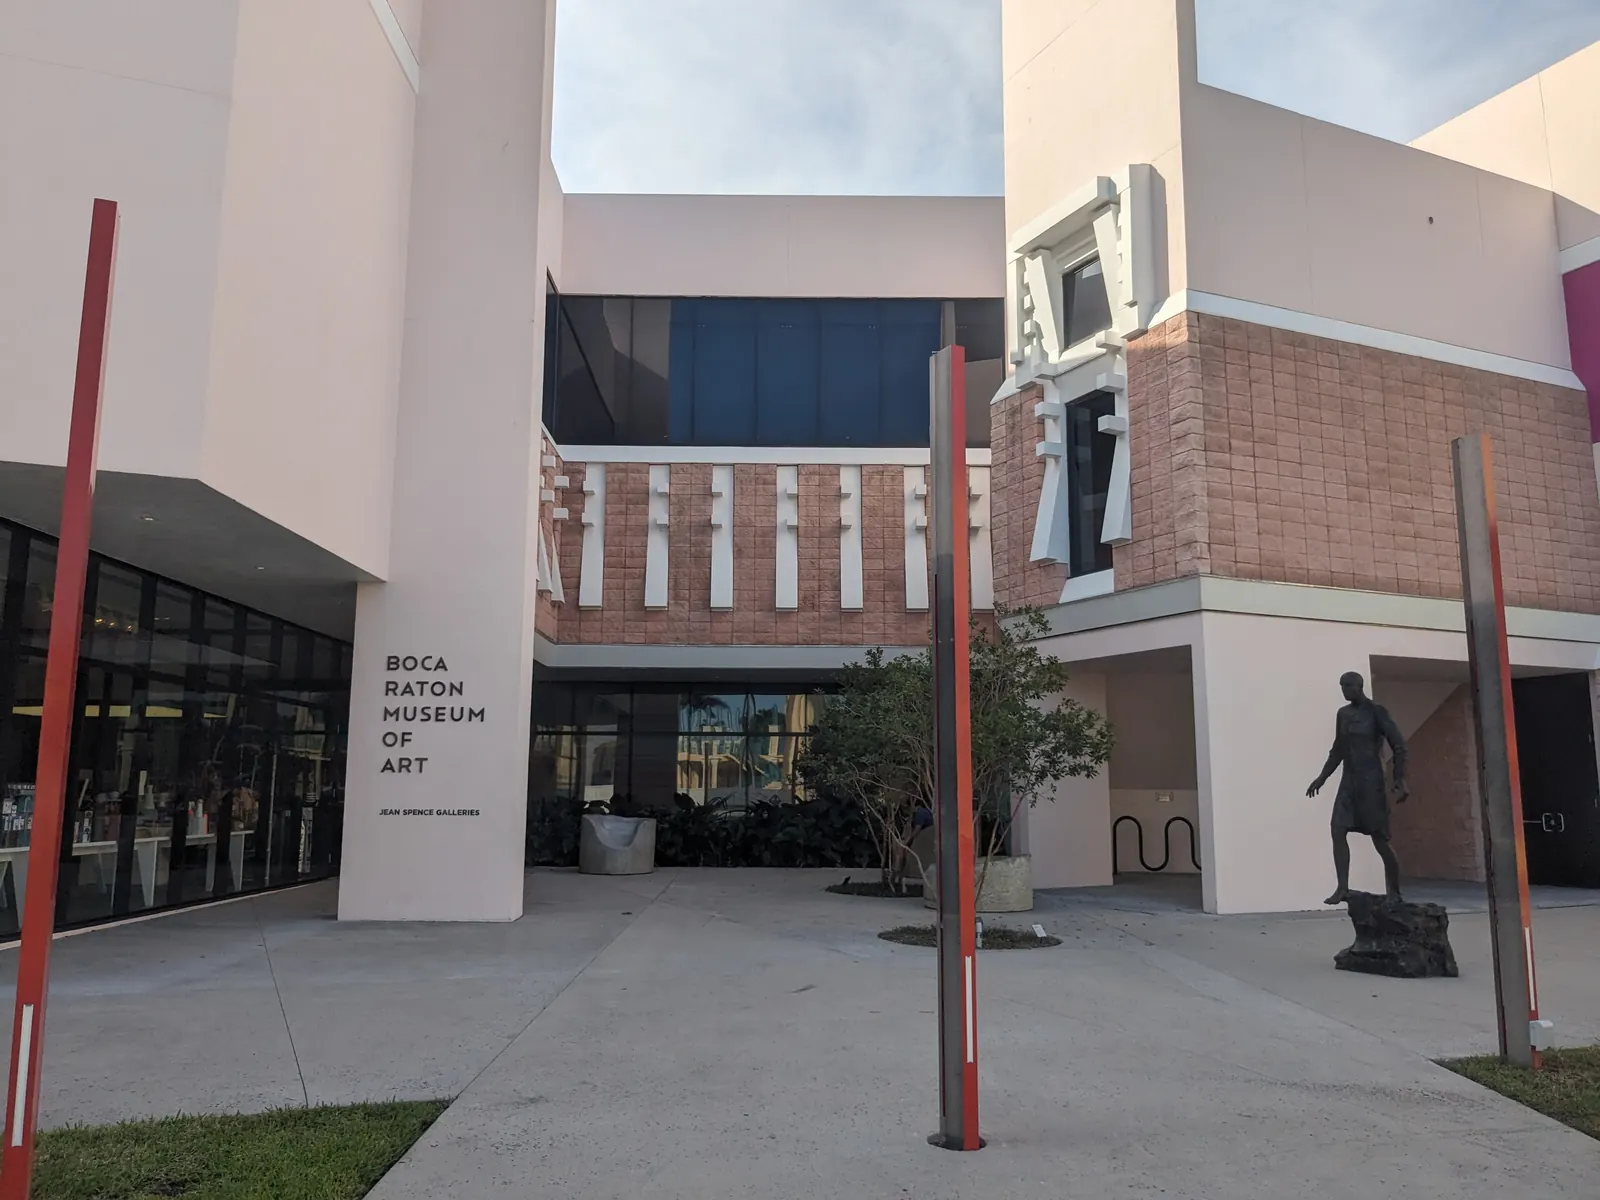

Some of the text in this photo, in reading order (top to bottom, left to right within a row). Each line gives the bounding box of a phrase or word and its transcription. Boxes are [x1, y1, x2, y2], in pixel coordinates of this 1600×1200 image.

[386, 655, 449, 672] BOCA
[384, 681, 464, 697] RATON
[383, 706, 485, 723] MUSEUM
[382, 731, 413, 748] OF
[380, 757, 429, 774] ART
[379, 808, 401, 816] JEAN
[436, 809, 481, 817] GALLERIES
